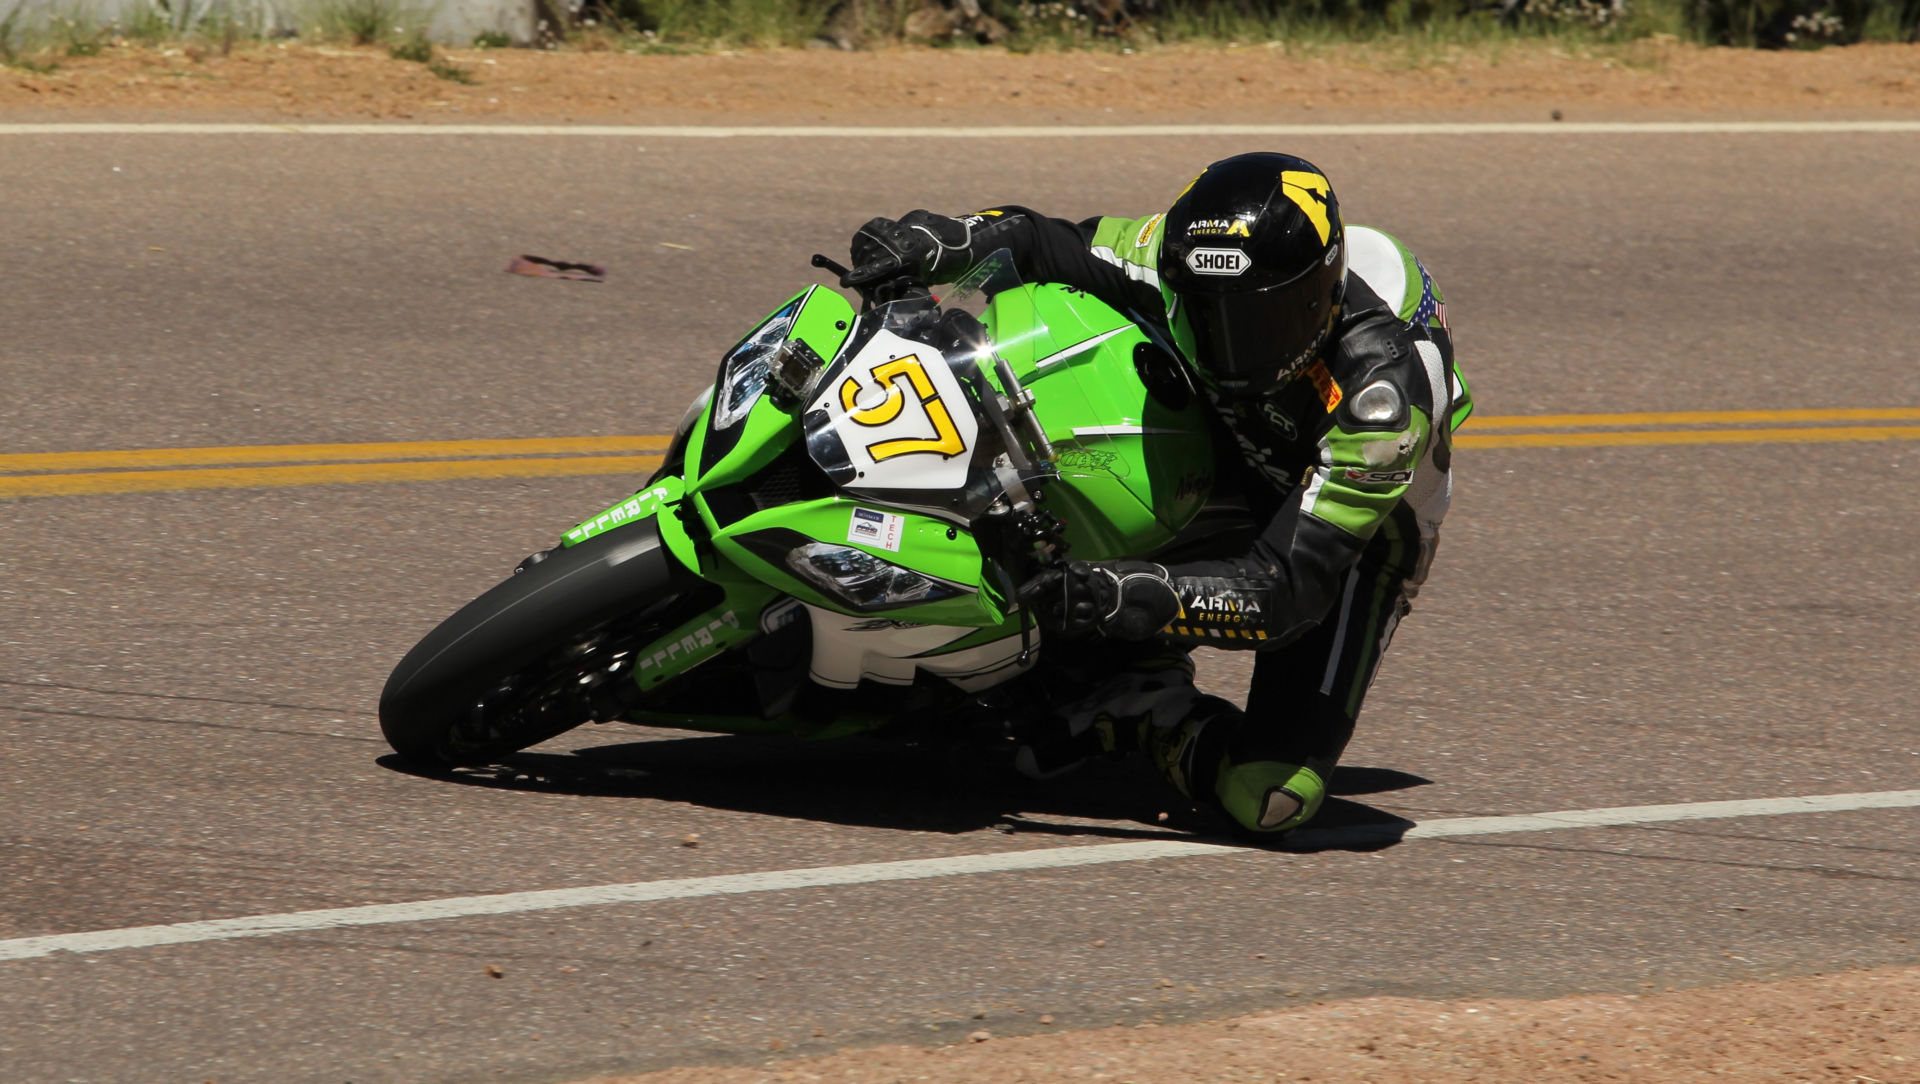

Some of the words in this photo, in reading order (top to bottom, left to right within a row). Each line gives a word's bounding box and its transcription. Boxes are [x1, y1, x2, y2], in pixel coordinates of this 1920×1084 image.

[1187, 219, 1229, 229] ARMA
[1193, 228, 1222, 236] ENERGY
[1195, 253, 1240, 270] SHOEI
[839, 353, 967, 464] 57
[568, 487, 668, 541] PIRELLI
[885, 515, 897, 549] TECH
[1190, 595, 1261, 613] ARMA
[1199, 612, 1250, 623] ENERGY
[639, 609, 740, 671] PIRELLI
